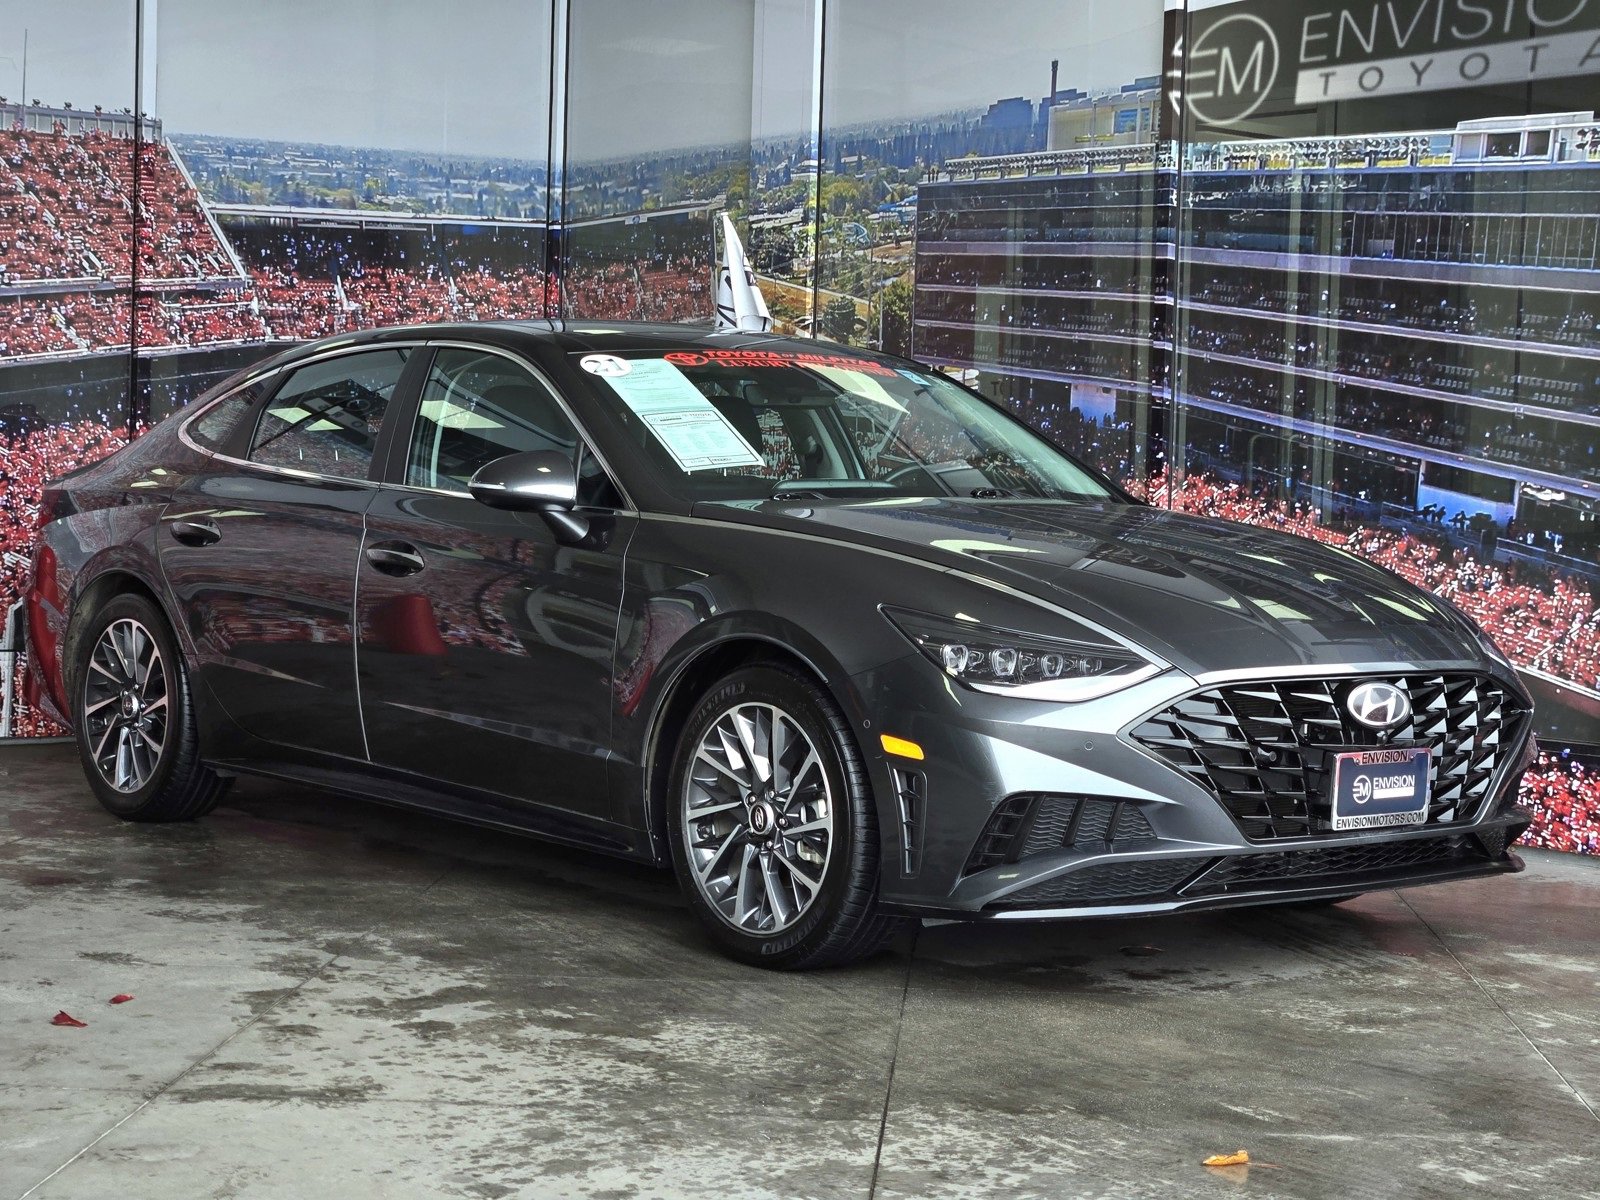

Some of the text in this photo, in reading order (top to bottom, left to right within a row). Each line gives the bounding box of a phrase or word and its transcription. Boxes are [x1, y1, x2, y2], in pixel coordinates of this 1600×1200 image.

[702, 349, 778, 360] TOYOTA
[796, 353, 882, 368] MILPITAS
[715, 359, 792, 369] LUXURY
[1362, 750, 1408, 764] ENVISION
[1373, 775, 1415, 789] ENVISION
[1336, 812, 1424, 829] ENVISIONMOTORS.COM
